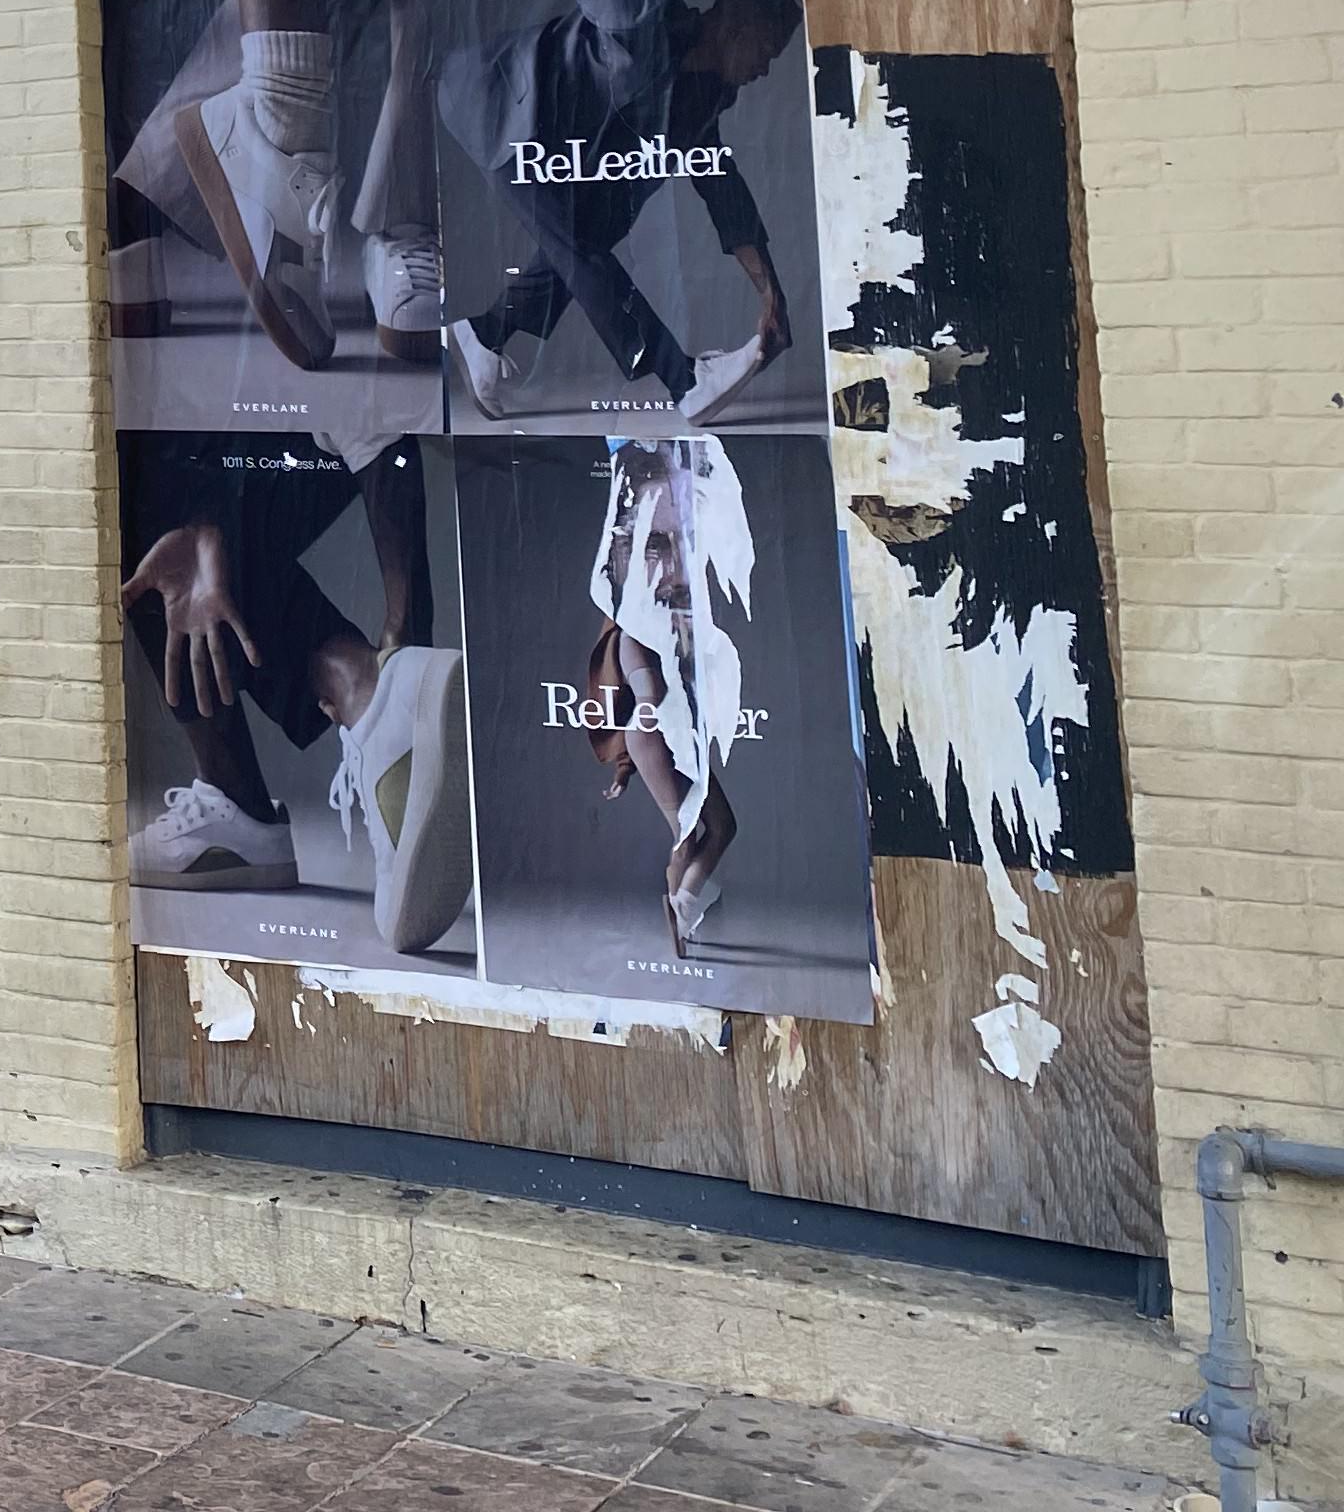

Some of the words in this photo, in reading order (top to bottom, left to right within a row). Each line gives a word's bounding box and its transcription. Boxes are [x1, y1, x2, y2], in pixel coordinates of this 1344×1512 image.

[509, 135, 733, 185] ReLeather
[233, 402, 309, 414] EVERLANE
[590, 399, 676, 411] EVERLANE
[222, 456, 244, 468] 1011
[259, 457, 314, 472] Congess
[540, 682, 769, 740] ReLeer
[258, 922, 339, 940] EVERLANE
[627, 959, 715, 979] EVERLANE
